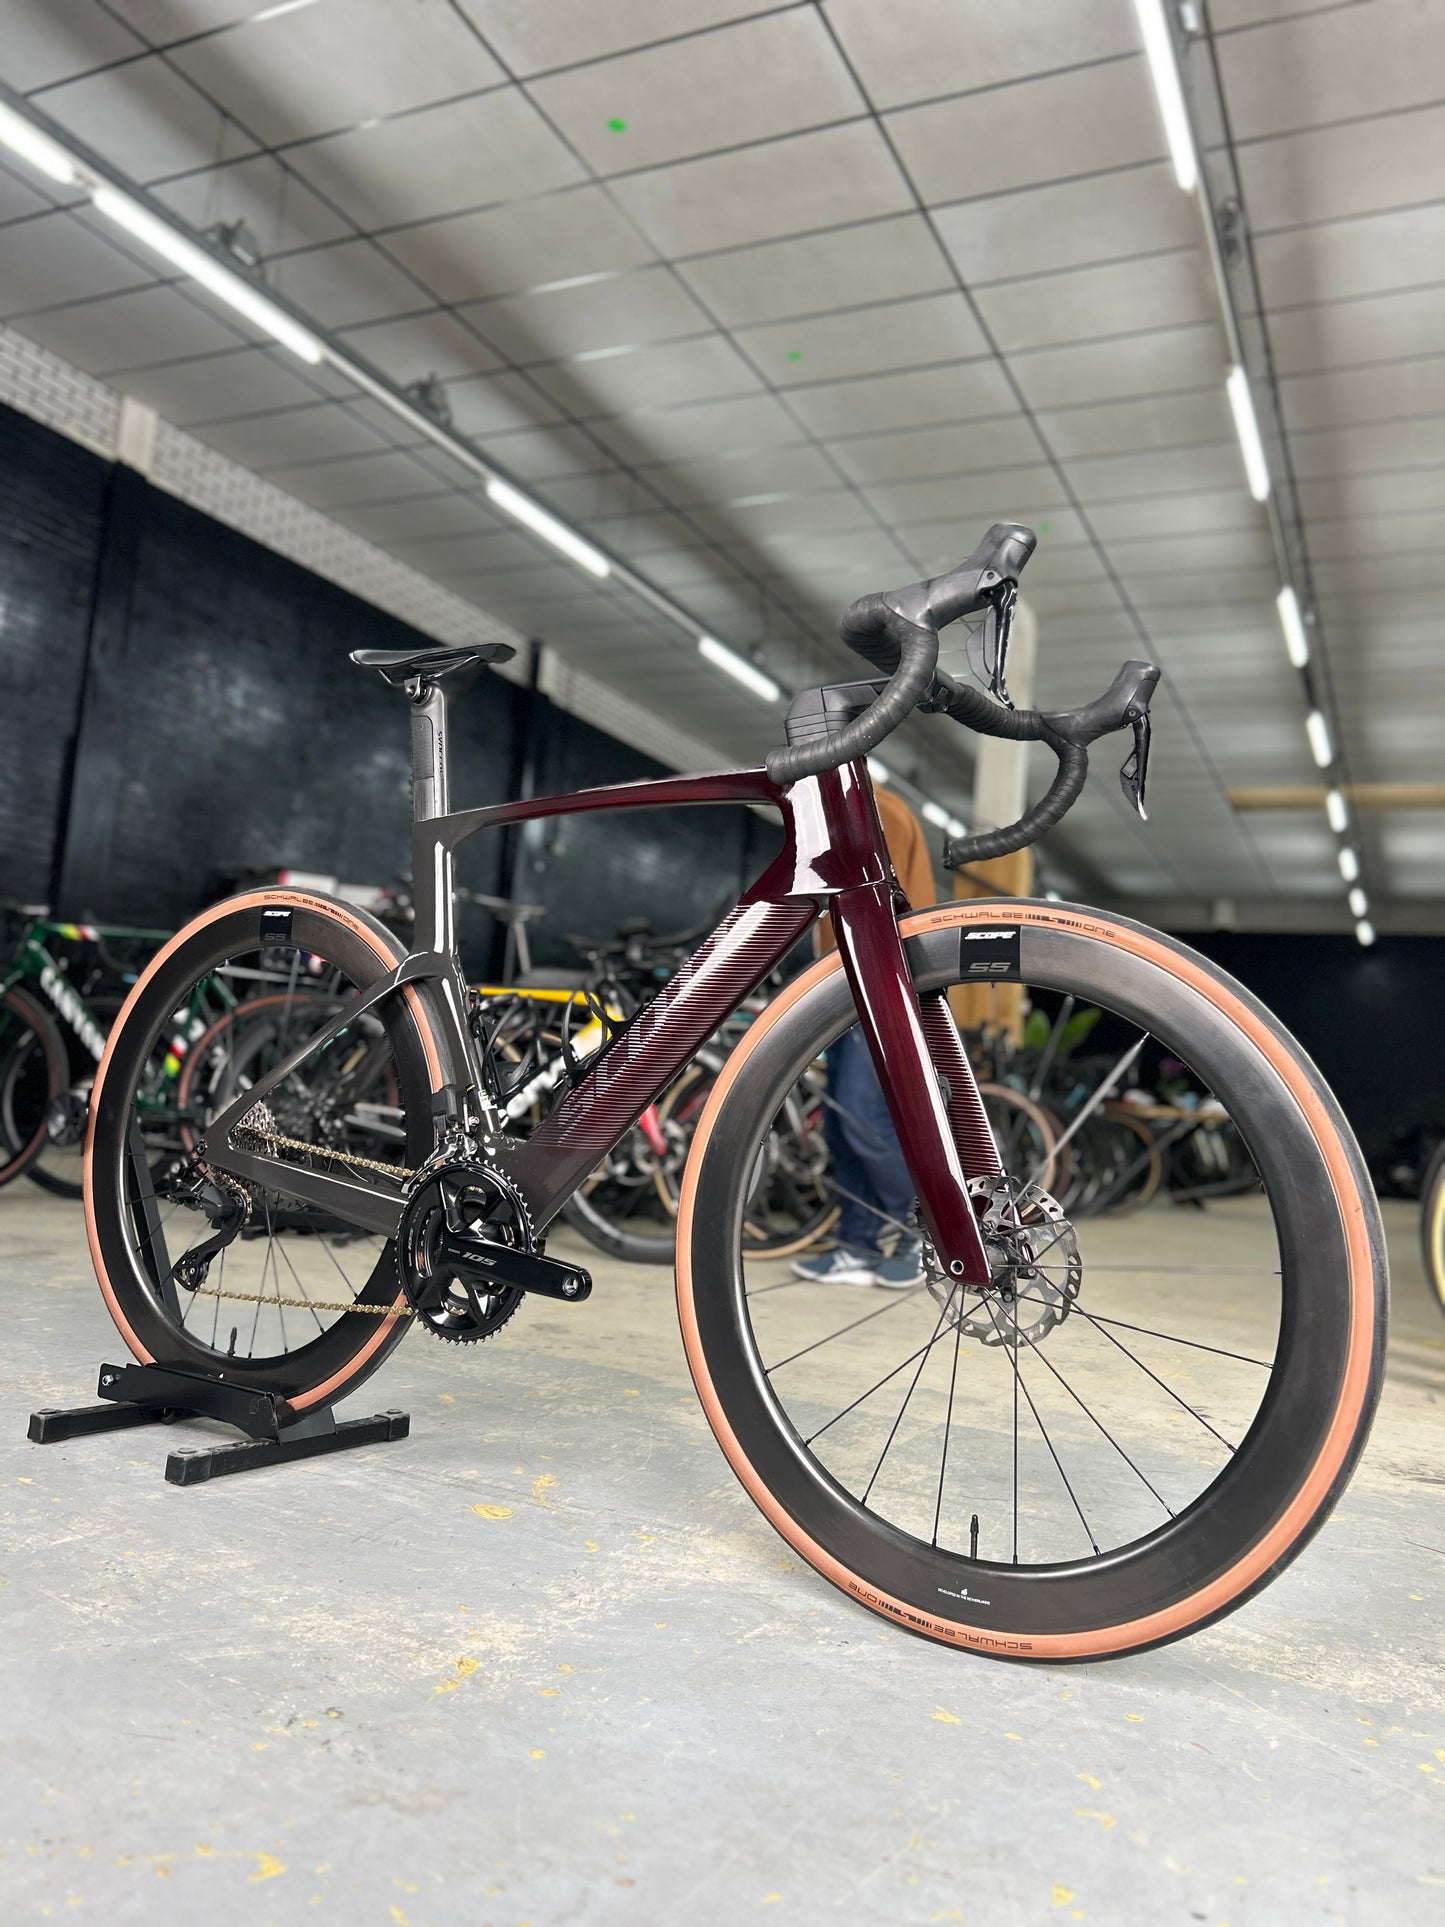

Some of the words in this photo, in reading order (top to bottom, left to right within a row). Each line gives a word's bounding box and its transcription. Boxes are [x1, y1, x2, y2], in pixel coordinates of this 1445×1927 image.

[930, 911, 1024, 924] SCHWALBE
[1083, 923, 1115, 938] ONE
[965, 931, 1016, 940] SCOPE
[968, 962, 1011, 973] 55
[462, 1251, 498, 1267] 105
[848, 1581, 878, 1603] ONE
[934, 1624, 1033, 1650] SCHWALBE
